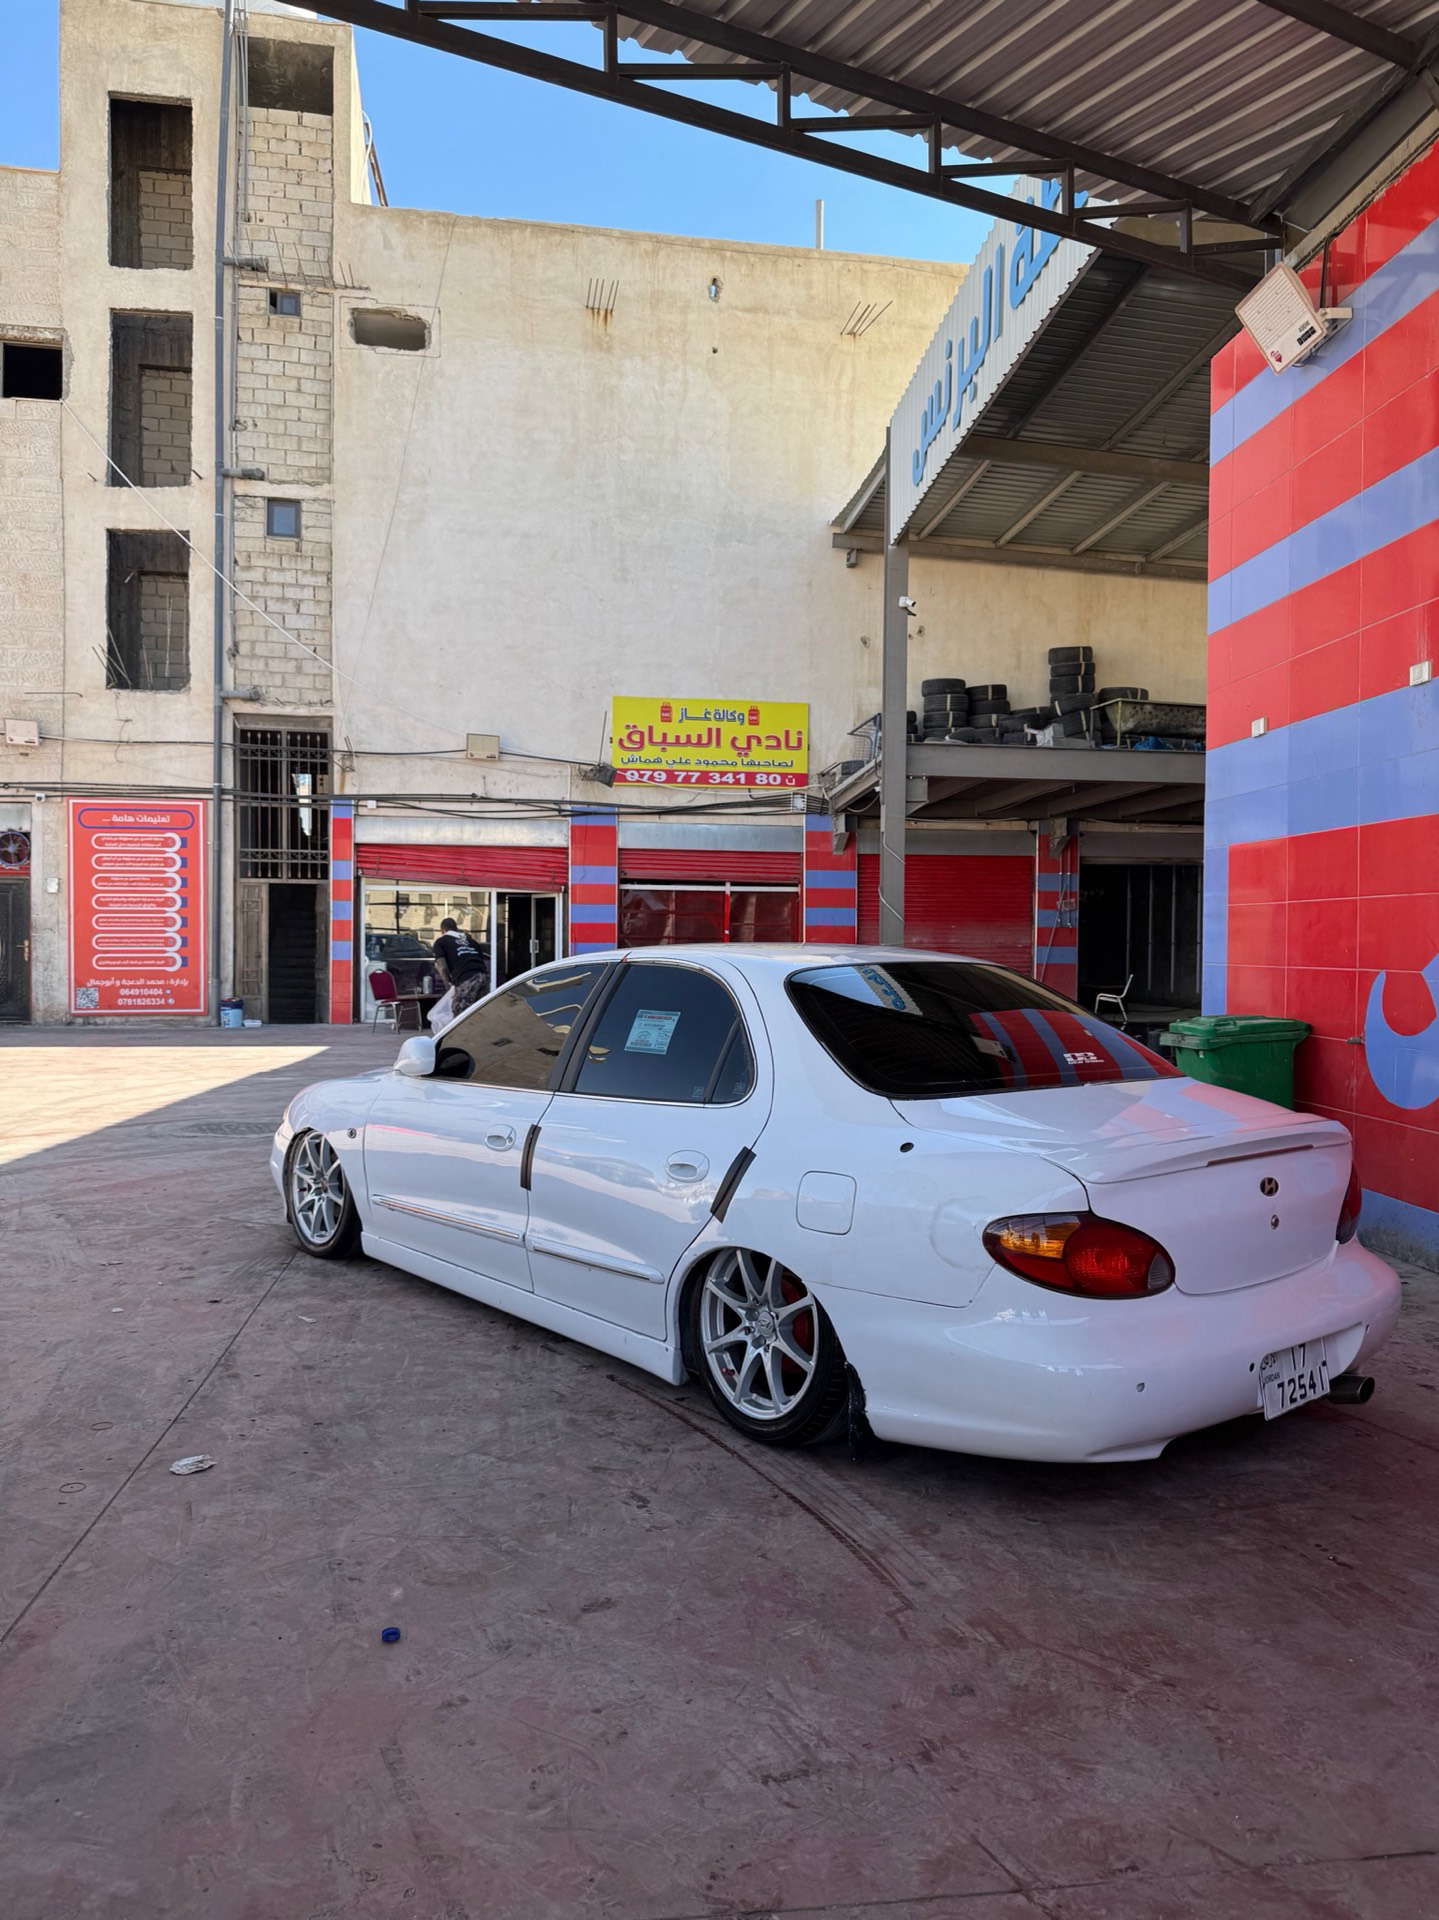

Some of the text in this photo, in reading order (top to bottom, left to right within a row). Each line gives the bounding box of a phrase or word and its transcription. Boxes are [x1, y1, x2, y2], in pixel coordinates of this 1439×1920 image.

[713, 707, 745, 726] وكالة
[618, 724, 803, 757] نادي السباق
[620, 754, 794, 768] لصاحبها محمود علي هماش
[625, 770, 782, 785] 079 77 341 80
[111, 813, 171, 825] تعليمات هامة
[1277, 1366, 1325, 1409] 72541
